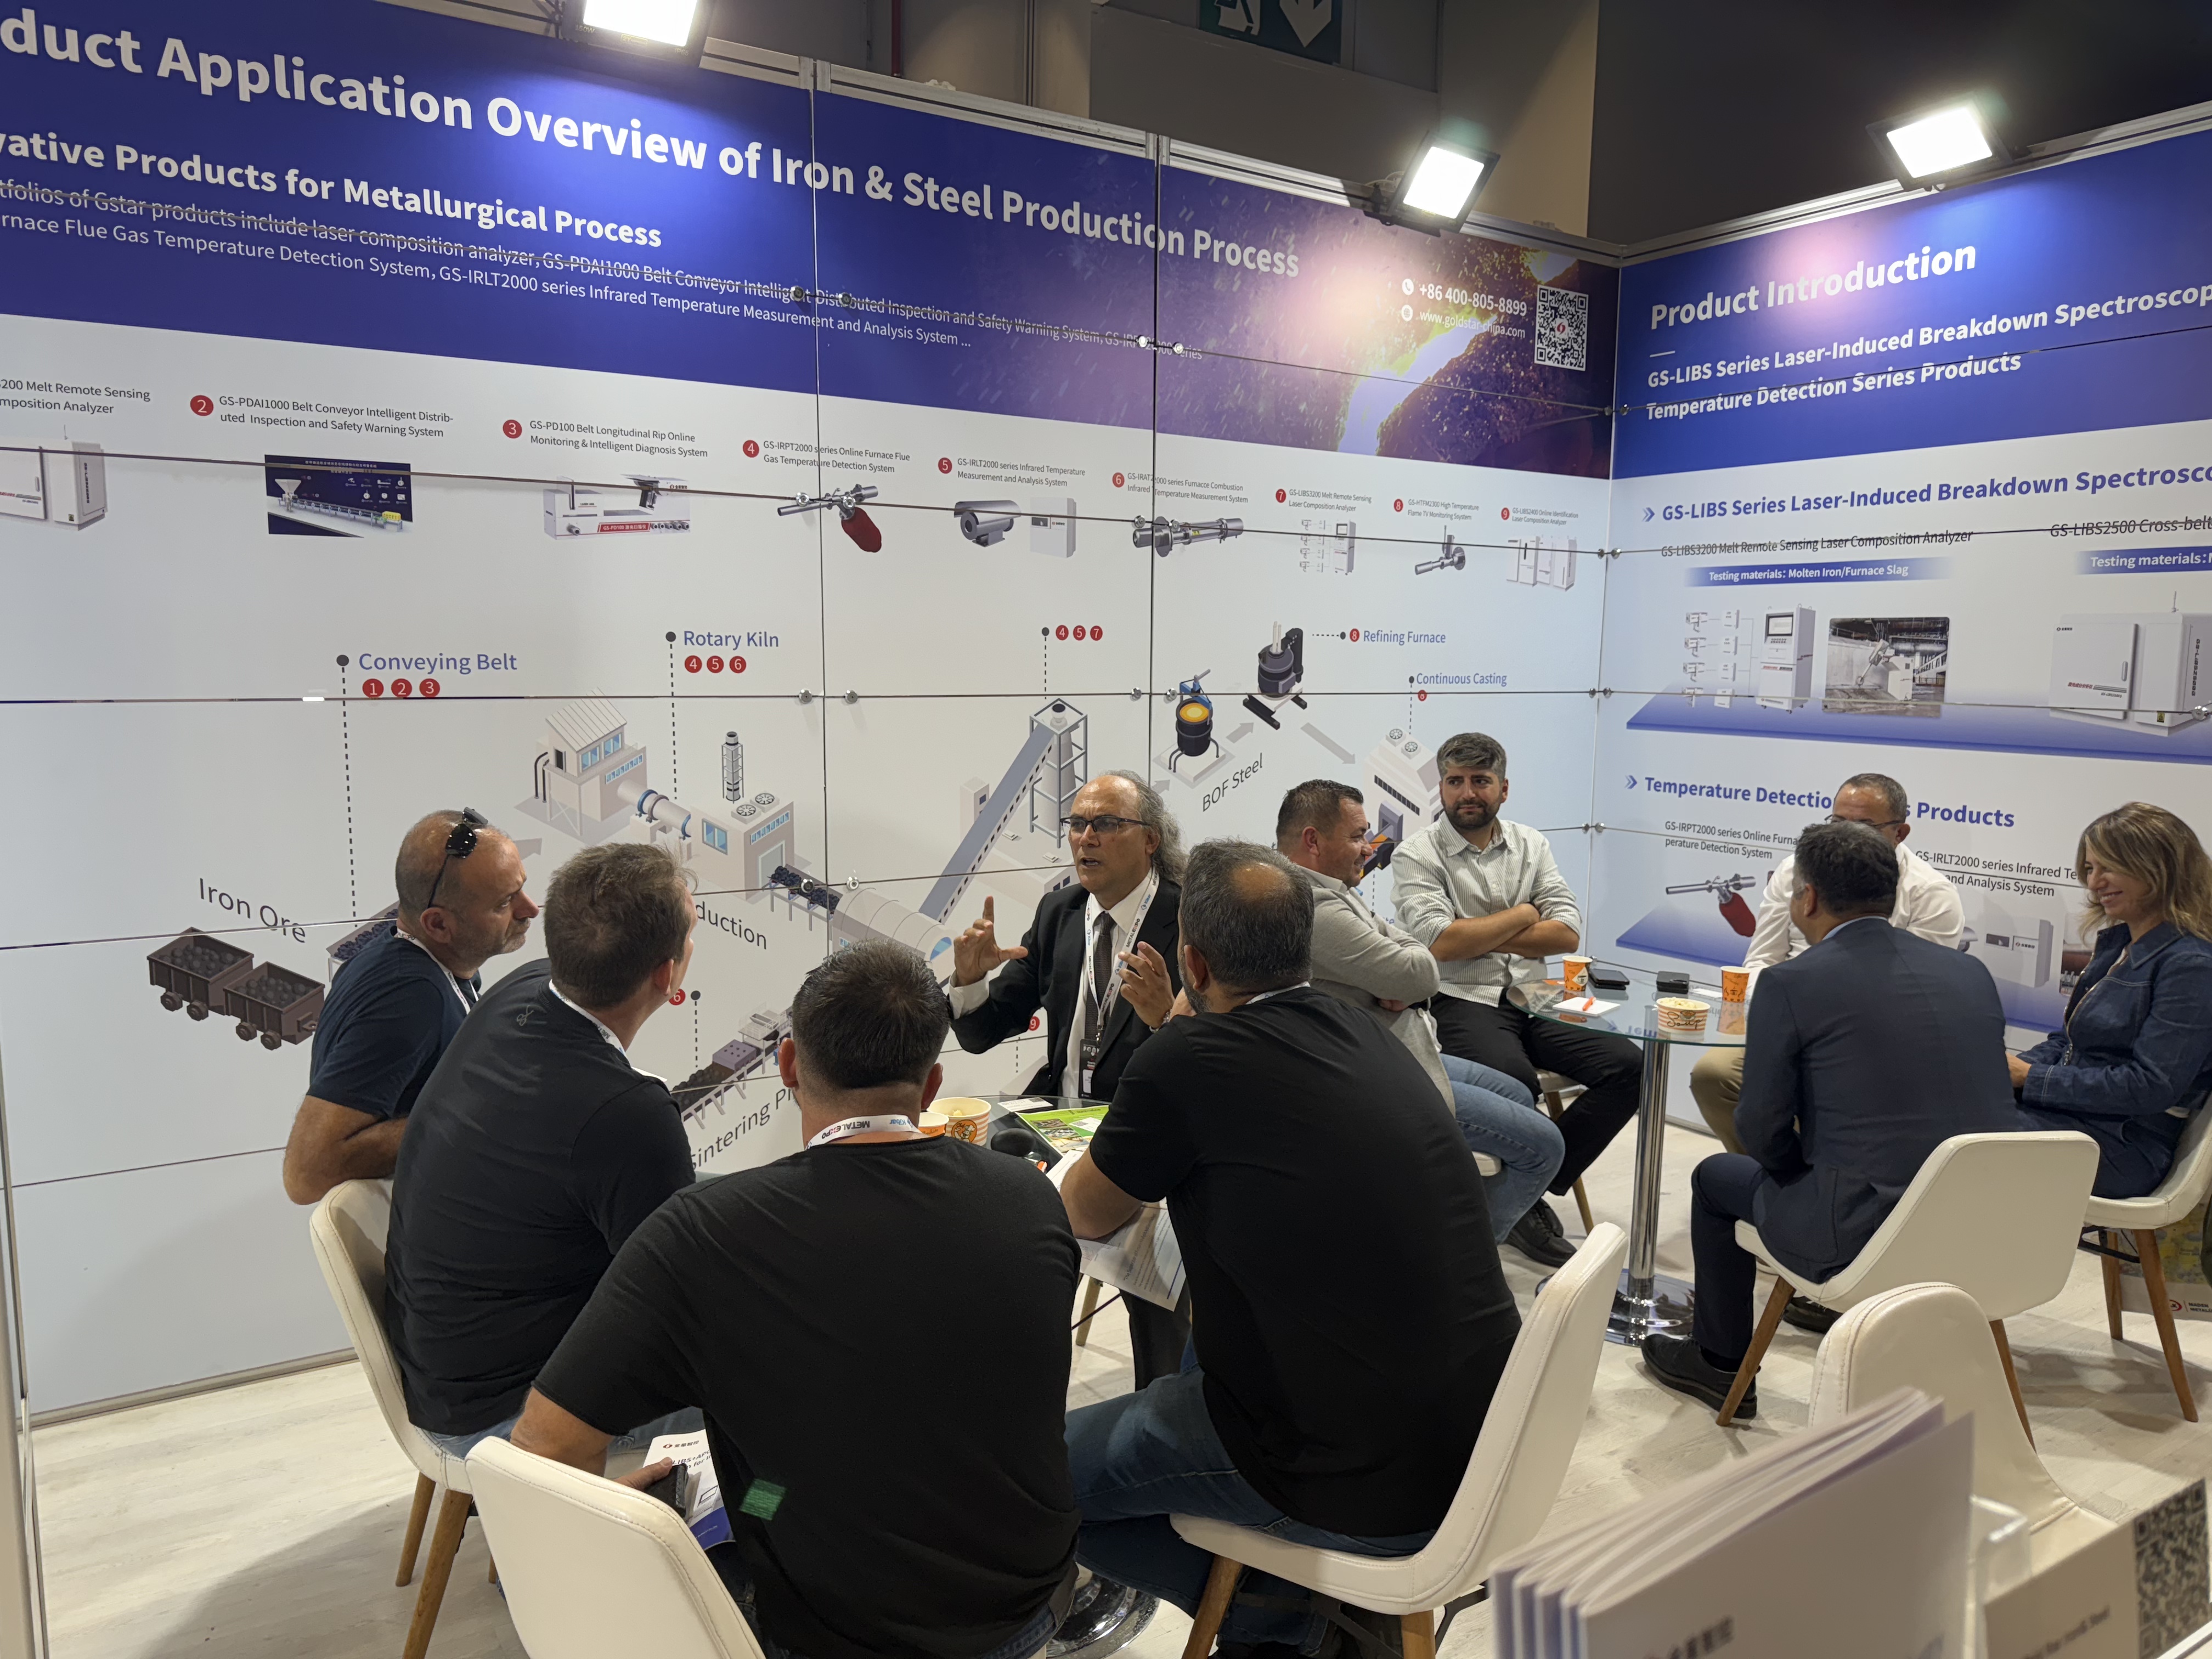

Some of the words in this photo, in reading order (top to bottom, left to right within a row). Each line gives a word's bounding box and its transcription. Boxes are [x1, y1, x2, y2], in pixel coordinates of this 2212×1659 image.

[0, 8, 142, 73] duct
[157, 38, 472, 129] Application
[488, 98, 707, 169] Overview
[719, 142, 761, 178] of
[773, 149, 853, 194] Iron
[866, 166, 893, 201] &
[904, 173, 993, 219] Steel
[1003, 190, 1184, 255] Production
[1194, 228, 1299, 278] Process
[116, 145, 276, 191] Products
[285, 169, 334, 199] for
[345, 179, 548, 231] Metallurgical
[555, 210, 661, 247] Process
[2, 215, 59, 233] rnace
[66, 219, 107, 238] Flue
[114, 225, 149, 243] Gas
[154, 230, 274, 258] Temperature
[280, 246, 364, 269] Detection
[370, 257, 435, 280] System,
[440, 267, 537, 291] GS-IRLT2000
[542, 281, 585, 297] series
[590, 285, 646, 304] Infrared
[651, 293, 740, 316] Temperature
[744, 305, 834, 328] Measurement
[838, 319, 860, 331] and
[864, 321, 913, 340] Analysis
[916, 329, 957, 345] System
[1652, 286, 1759, 329] Product
[1768, 246, 1976, 307] Introduction
[1419, 283, 1442, 301] +86
[1445, 287, 1527, 317] 400-805-8899
[1649, 363, 1712, 387] GS-LIBS
[1717, 356, 1769, 376] Series
[1775, 329, 1913, 368] Laser-Induced
[1920, 312, 2047, 345] Breakdown
[2055, 285, 2212, 326] Spectroscop
[0, 379, 22, 390] 200
[27, 381, 53, 392] Melt
[56, 383, 101, 396] Remote
[105, 387, 150, 402] Sensing
[1647, 393, 1752, 419] Temperature
[1757, 377, 1846, 405] Detection
[1852, 366, 1915, 392] Series
[1921, 352, 2021, 382] Products
[64, 402, 114, 414] Analyzer
[219, 396, 289, 409] GS-PDAI1000
[292, 402, 313, 411] Belt
[315, 404, 364, 416] Conveyor
[367, 408, 416, 421] Intelligent
[419, 412, 453, 422] Distrib-
[221, 414, 245, 422] uted
[251, 415, 305, 427] Inspection
[309, 420, 328, 428] and
[331, 421, 362, 433] Safety
[365, 423, 406, 436] Warning
[409, 426, 443, 437] System
[530, 421, 574, 432] GS-PD100
[577, 425, 594, 433] Belt
[597, 426, 650, 438] Longitudinal
[653, 431, 665, 441] Rip
[668, 432, 695, 442] Online
[531, 436, 579, 449] Monitoring
[590, 440, 633, 452] Intelligent
[636, 444, 676, 455] Diagnosis
[678, 447, 707, 457] System
[764, 441, 812, 452] GS-IRPT2000
[839, 448, 863, 456] Online
[865, 450, 893, 459] Furnace
[895, 453, 910, 461] Flue
[764, 455, 778, 463] Gas
[832, 460, 867, 470] Detection
[869, 464, 894, 473] System
[958, 458, 998, 468] GS-IRLT2000
[1020, 464, 1044, 472] Infrared
[1046, 466, 1085, 476] Temperature
[958, 471, 1002, 481] Measurement
[1018, 476, 1043, 486] Analysis
[1045, 478, 1067, 487] System
[1191, 492, 1227, 501] Measurement
[1663, 501, 1726, 520] GS-LIBS
[1732, 497, 1785, 515] Series
[1792, 484, 1931, 511] Laser-Induced
[1938, 477, 2067, 500] Breakdown
[2075, 466, 2212, 494] Spectrosco
[2051, 520, 2136, 537] GS-LIBS2500
[2140, 515, 2212, 533] Cross-belt
[2090, 555, 2136, 569] Testing
[2138, 552, 2207, 566] materials:
[1709, 571, 1739, 582] Testing
[1741, 568, 1786, 580] materials:
[1788, 568, 1820, 578] Molten
[1822, 567, 1884, 578] Iron/Furnace
[1887, 565, 1909, 577] Slag
[684, 631, 741, 650] Rotary
[747, 631, 778, 647] Kiln
[1364, 630, 1404, 646] Refining
[1408, 631, 1446, 643] Furnace
[359, 653, 471, 674] Conveying
[477, 653, 517, 670] Belt
[1417, 673, 1470, 684] Continuous
[1474, 673, 1506, 687] Casting
[1203, 779, 1229, 812] BOF
[1232, 752, 1262, 789] Steel
[1645, 777, 1751, 801] Temperature
[1756, 787, 1831, 809] Detectio
[1917, 802, 2015, 827] Products
[1665, 821, 1716, 836] GS-IRPT2000
[1718, 827, 1741, 838] series
[1743, 830, 1771, 843] Online
[1665, 838, 1699, 849] perature
[1701, 840, 1739, 855] Detection
[1741, 847, 1772, 859] System
[1982, 860, 2013, 872] series
[2017, 862, 2061, 878] Infrared
[1967, 875, 2011, 891] Analysis
[2013, 882, 2055, 896] System
[200, 878, 251, 919] Iron
[260, 905, 306, 943] Ore
[1667, 1011, 1704, 1029] Soup
[691, 1103, 770, 1170] Sintering
